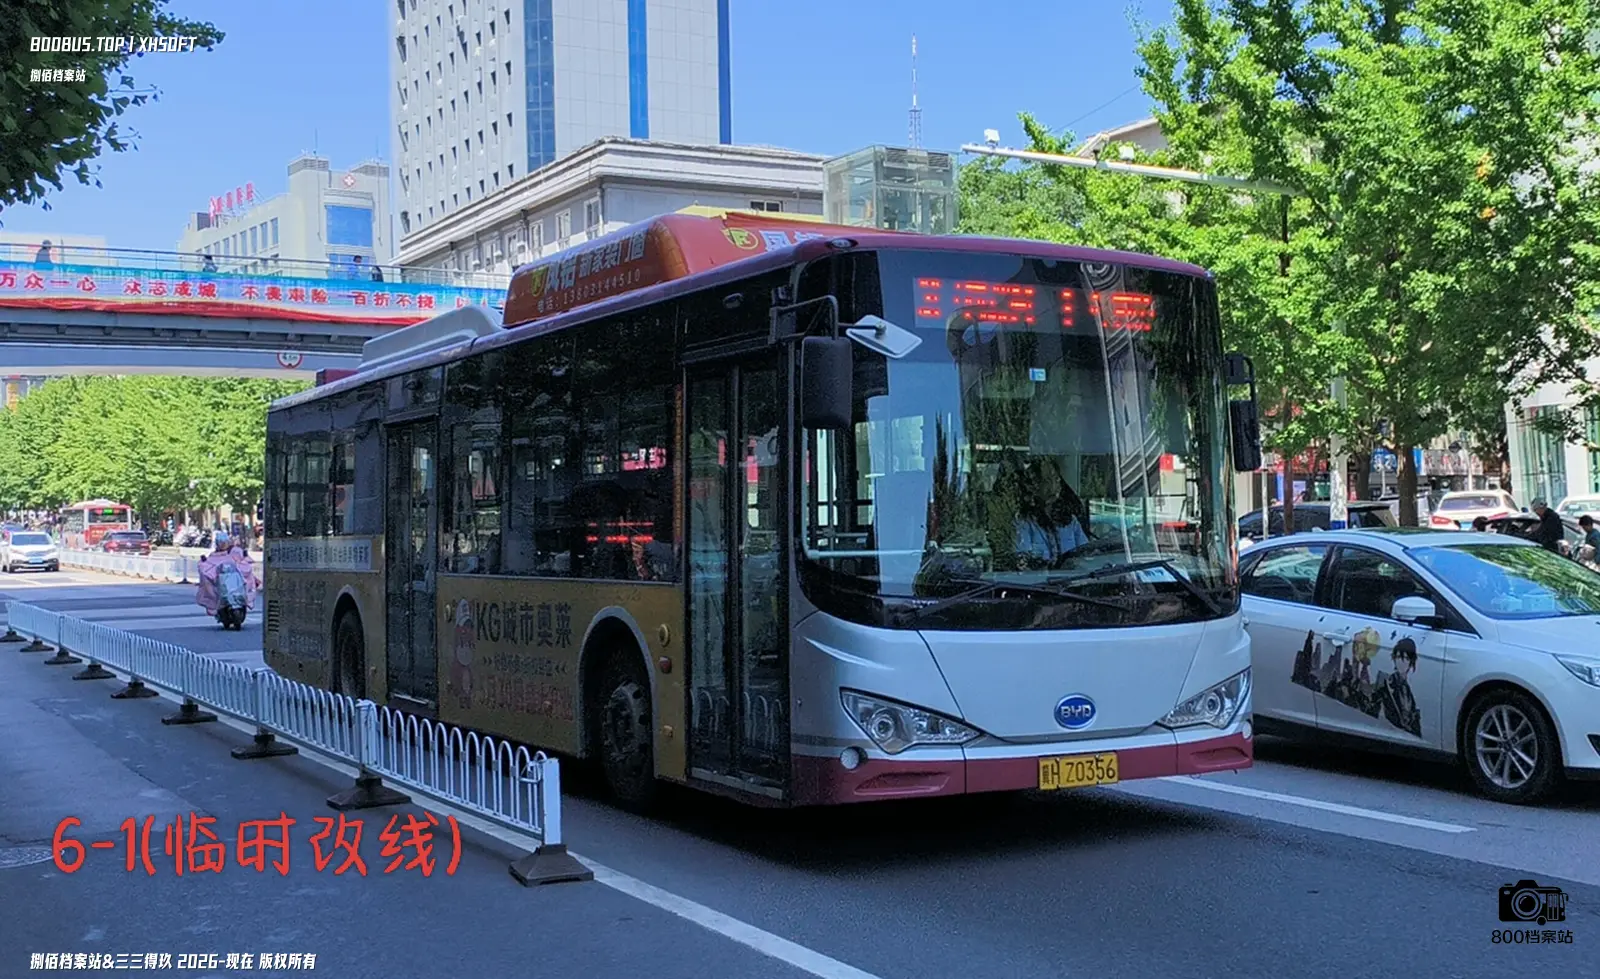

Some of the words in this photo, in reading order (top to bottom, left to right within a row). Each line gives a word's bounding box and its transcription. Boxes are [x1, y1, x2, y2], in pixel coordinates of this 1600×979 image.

[0, 272, 96, 292] 万众一心
[123, 279, 217, 298] 众志成城
[241, 286, 328, 303] 不畏艰险
[351, 291, 434, 309] 百折不挠
[1060, 704, 1092, 718] BYD
